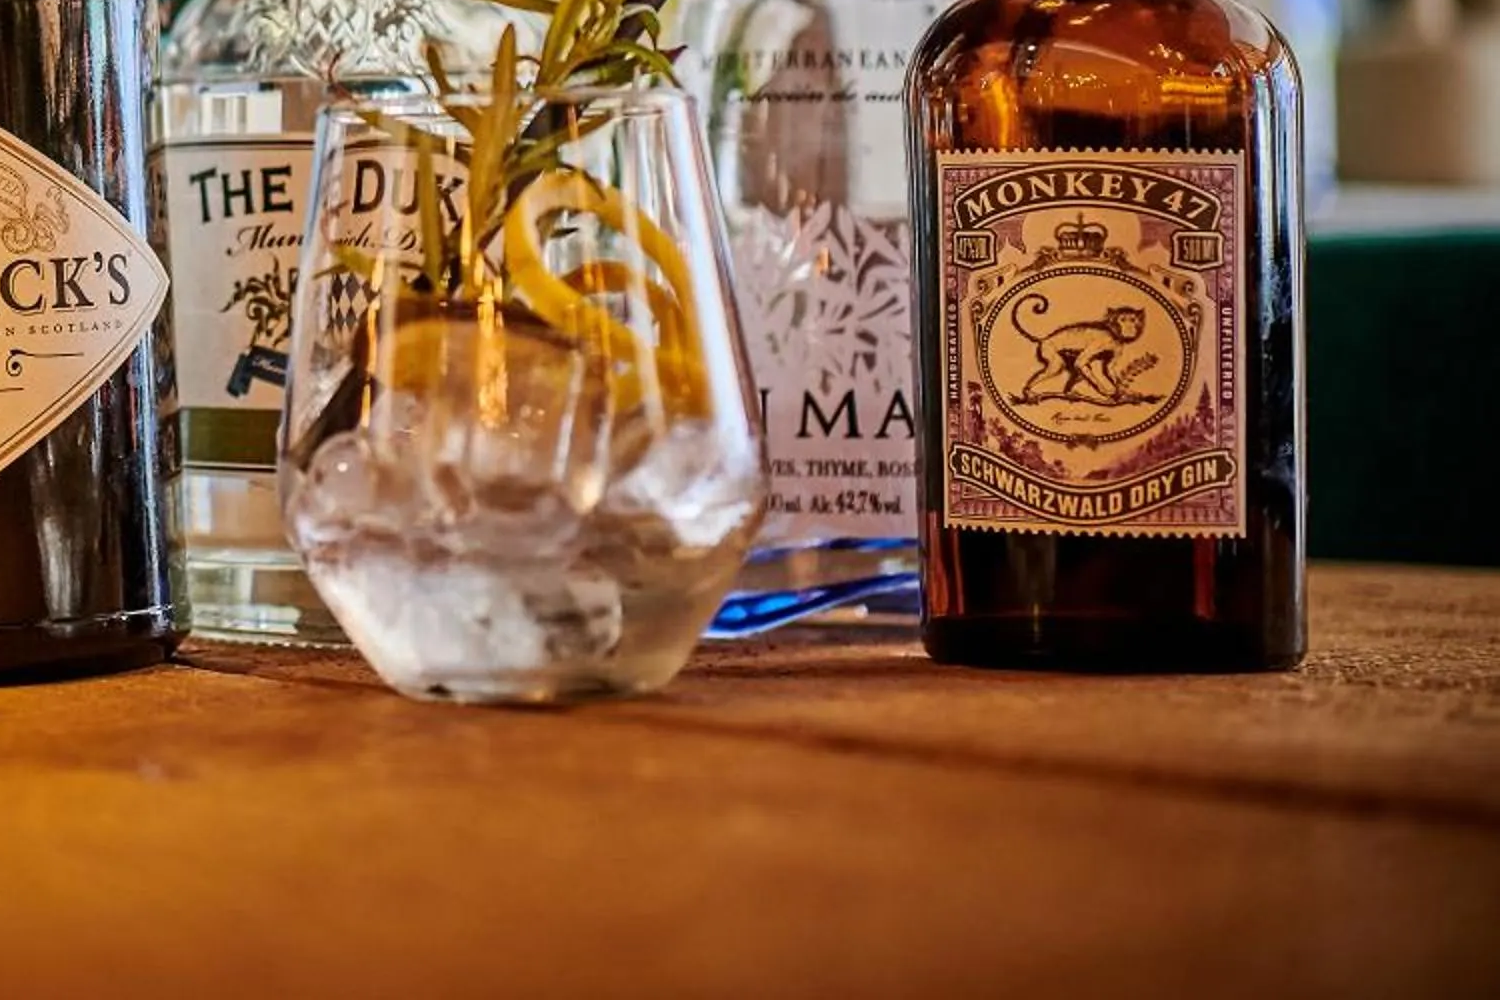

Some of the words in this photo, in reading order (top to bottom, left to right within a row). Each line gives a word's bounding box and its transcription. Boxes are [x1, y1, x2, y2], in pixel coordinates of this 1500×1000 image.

[189, 164, 294, 224] THE
[351, 159, 465, 222] DUK
[963, 170, 1159, 223] MONKEY
[1163, 189, 1210, 221] 47
[27, 320, 123, 336] SCOTLAND
[947, 303, 959, 399] HANDCRAFTED
[1221, 307, 1233, 399] UNFILTERED
[806, 460, 873, 478] THYME,
[960, 452, 1122, 519] SCHWARZWALD
[1130, 474, 1173, 507] DRY
[1181, 458, 1218, 488] GIN
